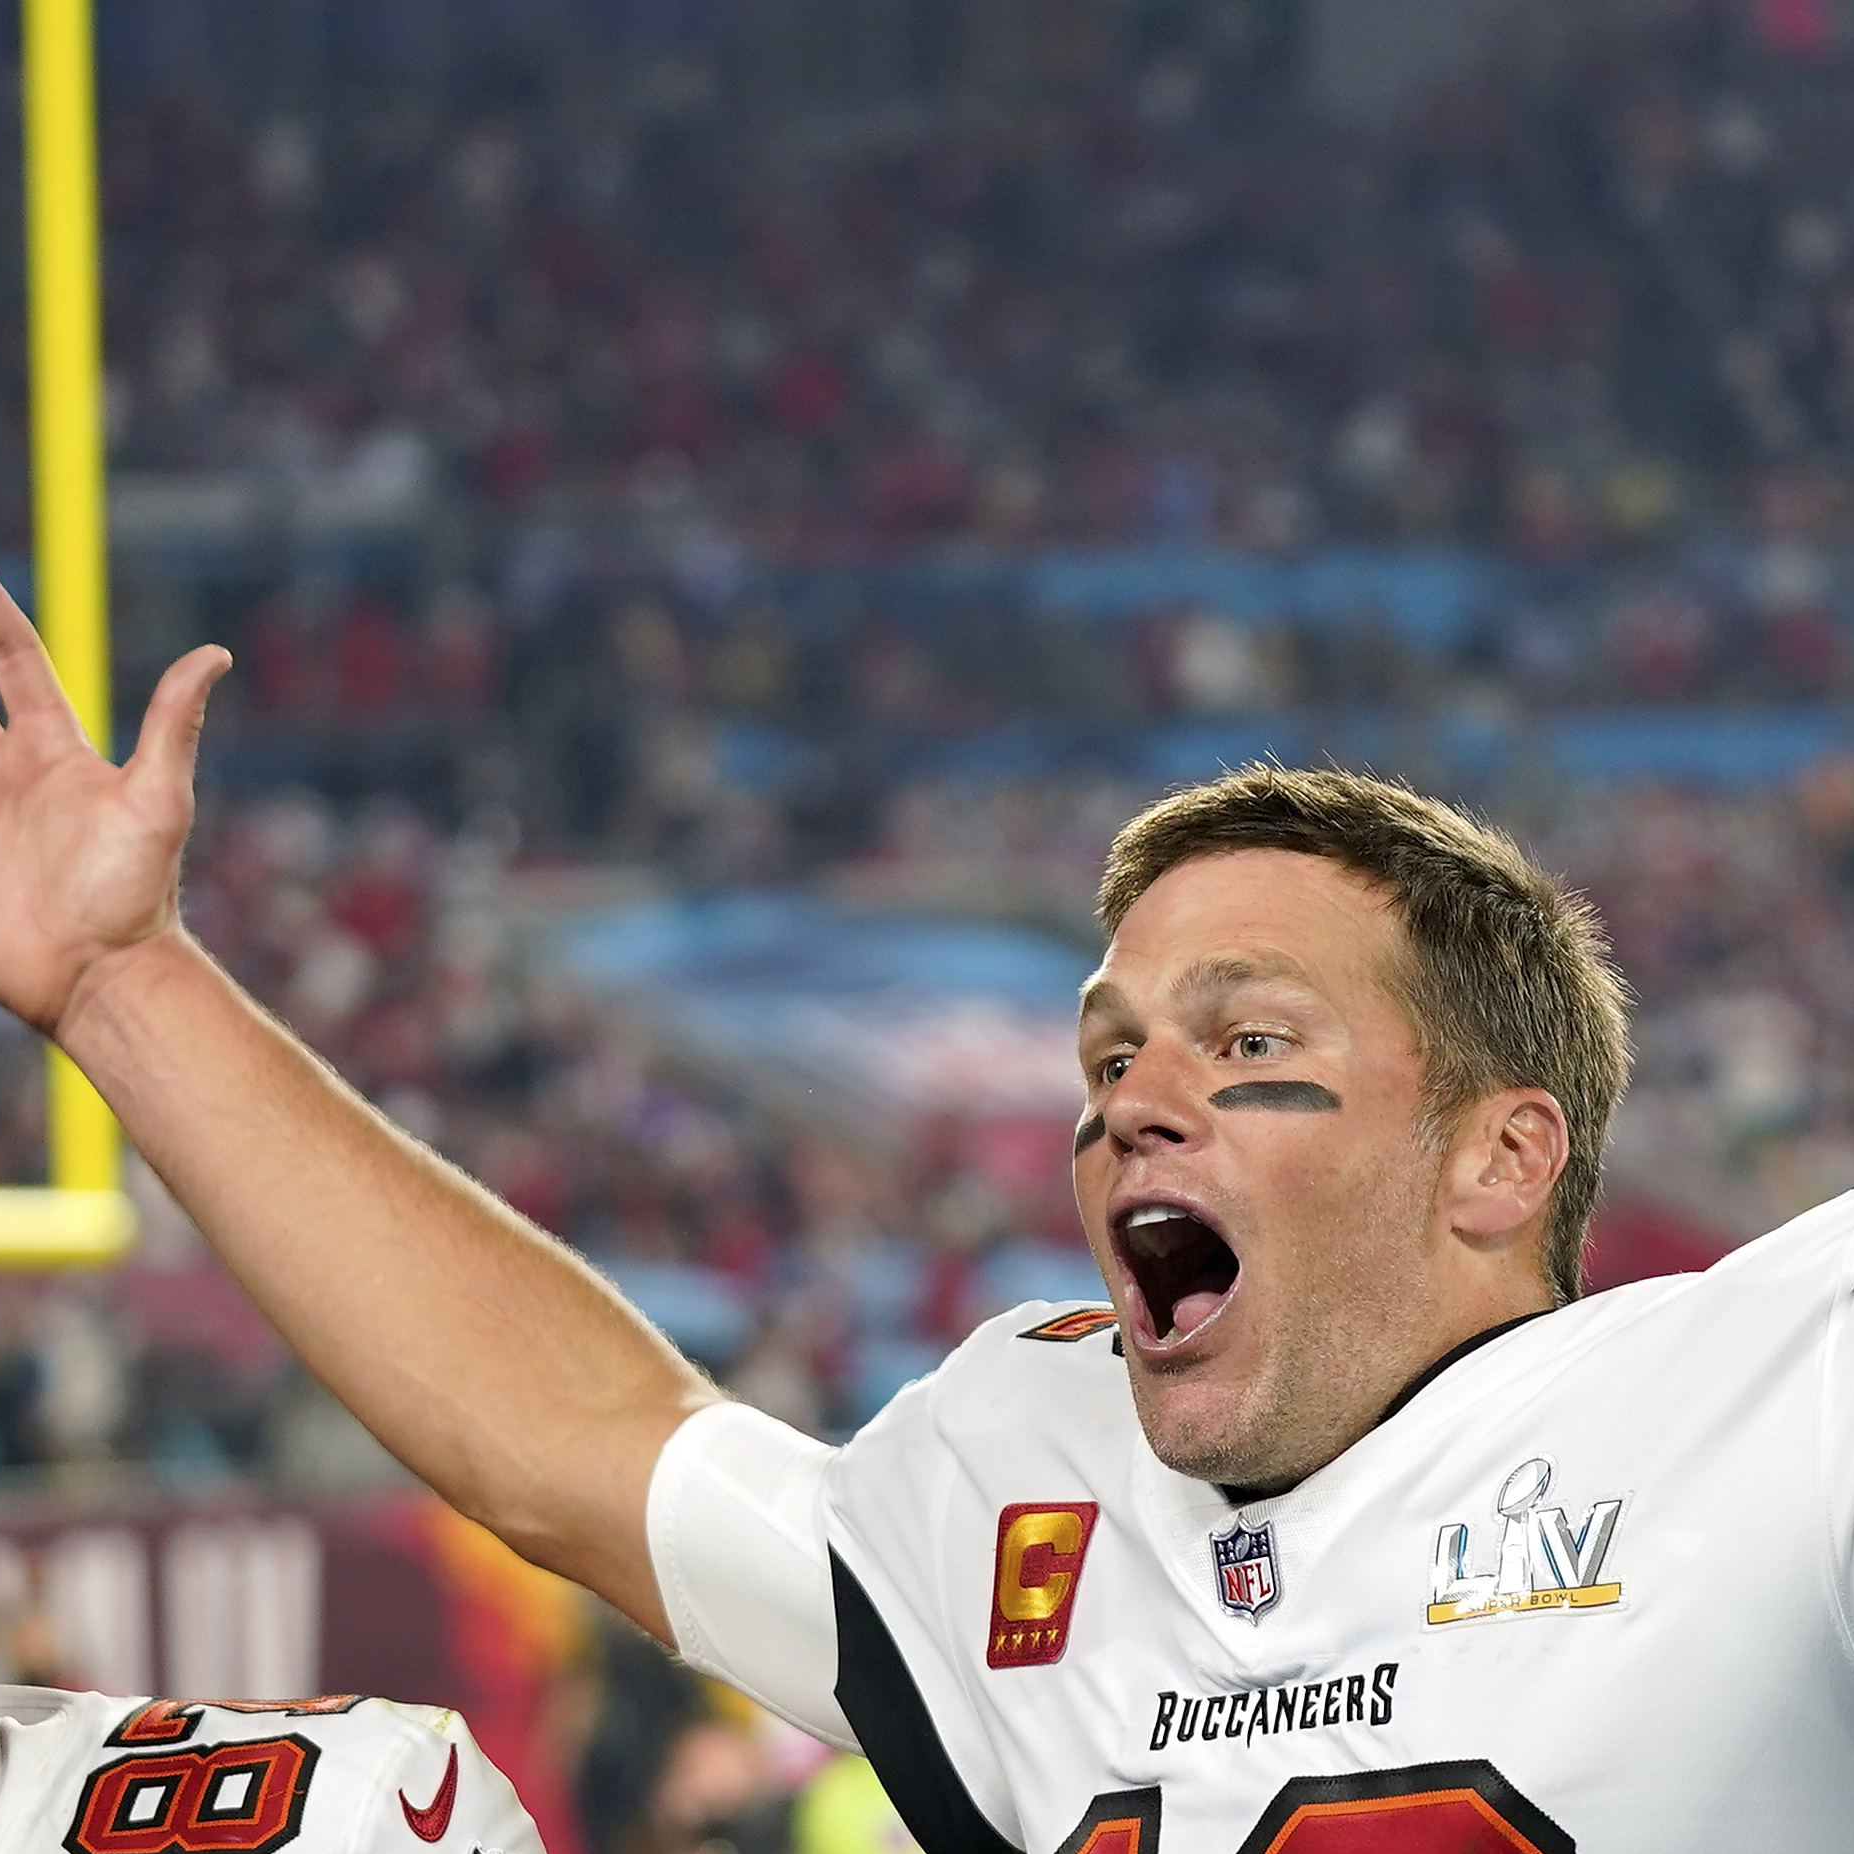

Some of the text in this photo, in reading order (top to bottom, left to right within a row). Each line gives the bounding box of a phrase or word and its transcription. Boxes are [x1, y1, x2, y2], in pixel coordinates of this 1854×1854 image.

[999, 1511, 1082, 1621] C
[1224, 1562, 1272, 1606] NFL
[1530, 1592, 1579, 1606] BOWL
[1149, 1662, 1400, 1750] BUCCANEERS
